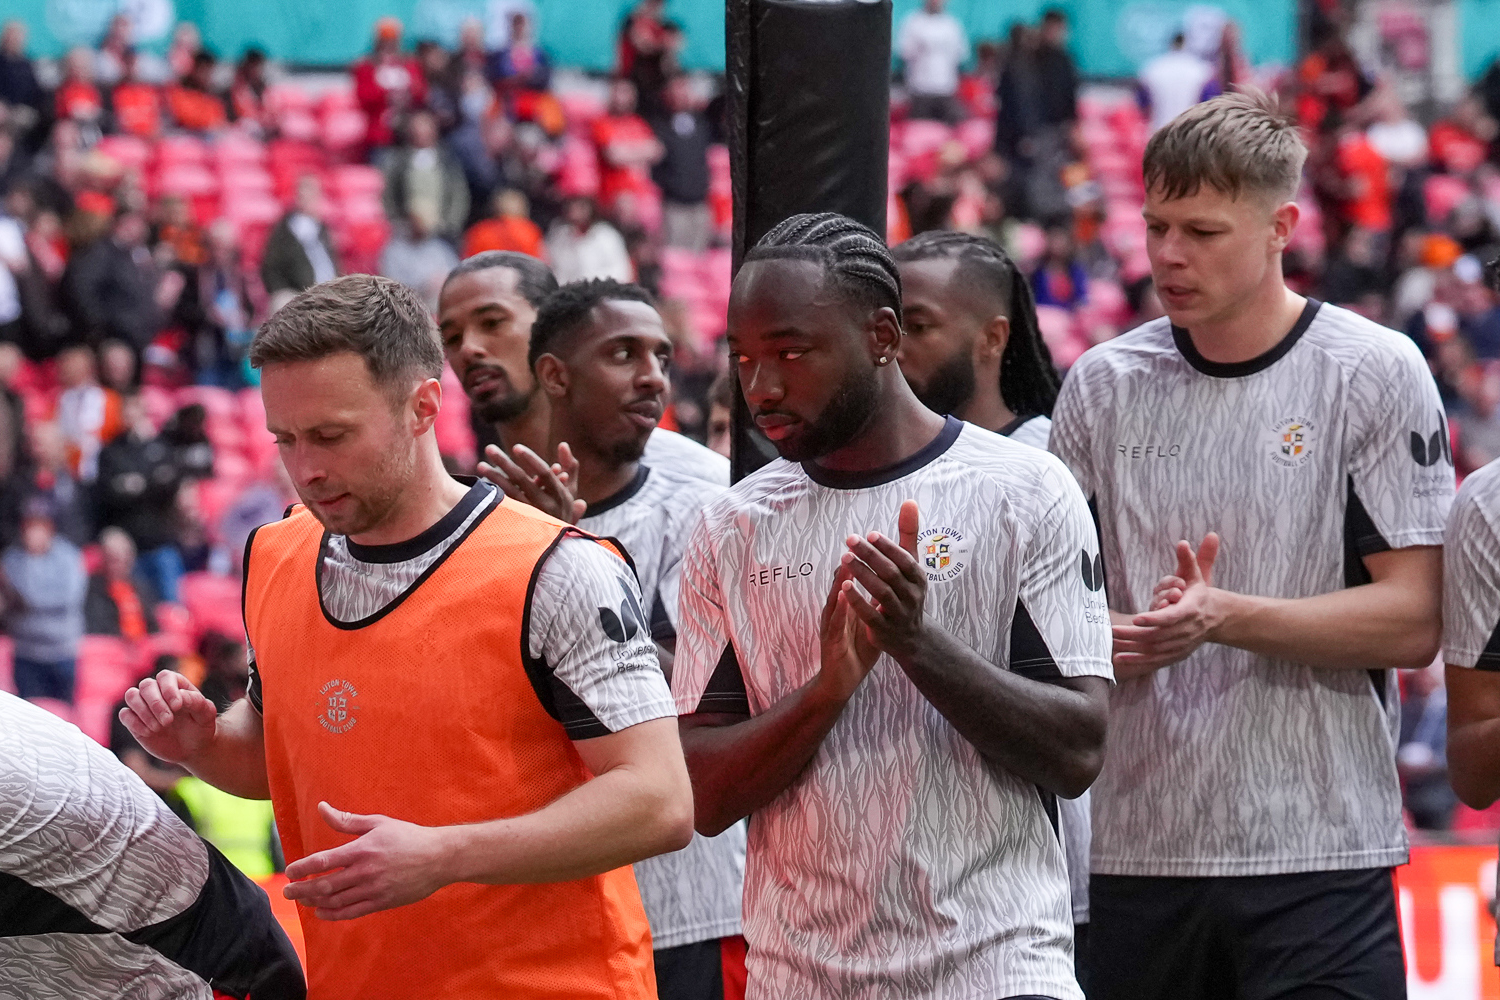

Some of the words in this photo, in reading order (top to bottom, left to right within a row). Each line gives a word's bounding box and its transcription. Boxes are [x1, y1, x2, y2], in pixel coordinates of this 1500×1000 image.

[1117, 444, 1181, 459] REFLO
[941, 526, 964, 542] TOWN
[749, 562, 814, 587] REFLO
[947, 561, 965, 579] CLUB
[320, 679, 340, 695] LUTON
[342, 680, 358, 698] TOWN
[343, 717, 357, 732] CLUB
